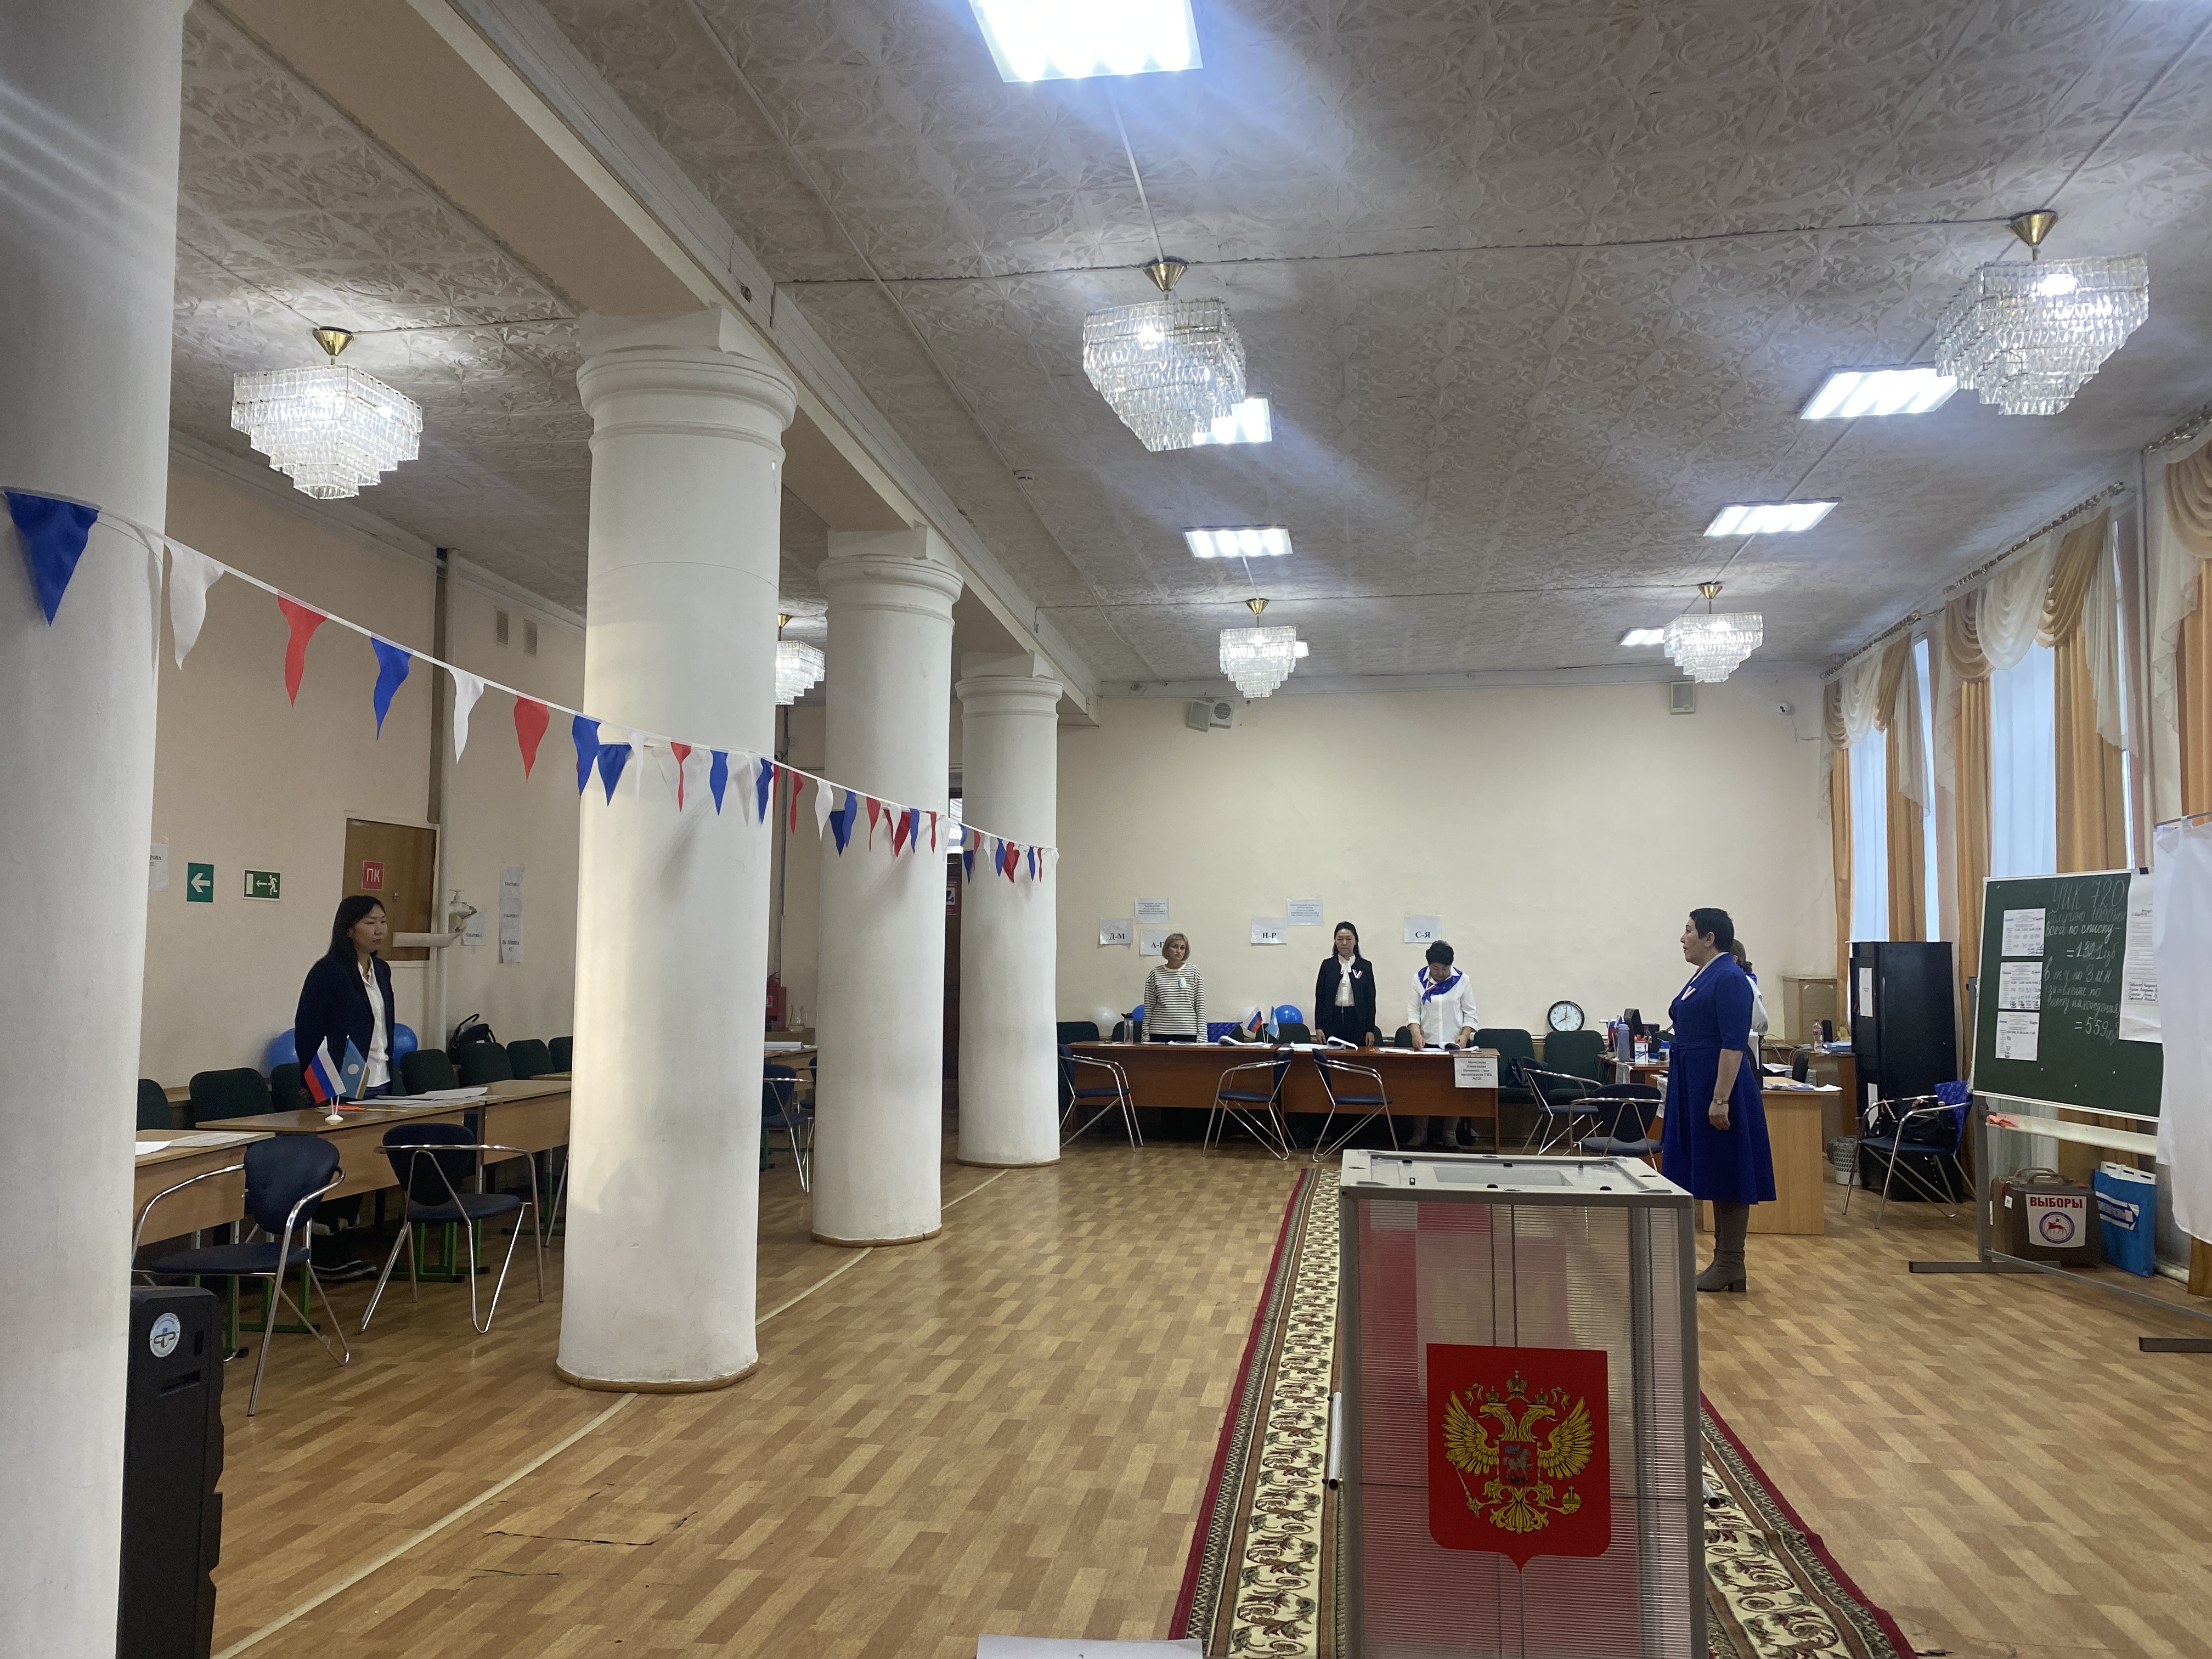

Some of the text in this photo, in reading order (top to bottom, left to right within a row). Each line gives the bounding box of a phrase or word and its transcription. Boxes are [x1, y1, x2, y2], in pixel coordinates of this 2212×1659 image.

[366, 868, 380, 882] ПК
[2091, 879, 2125, 907] 720
[2069, 925, 2079, 935] по
[2030, 1197, 2083, 1209] ВЫБОРЫ
